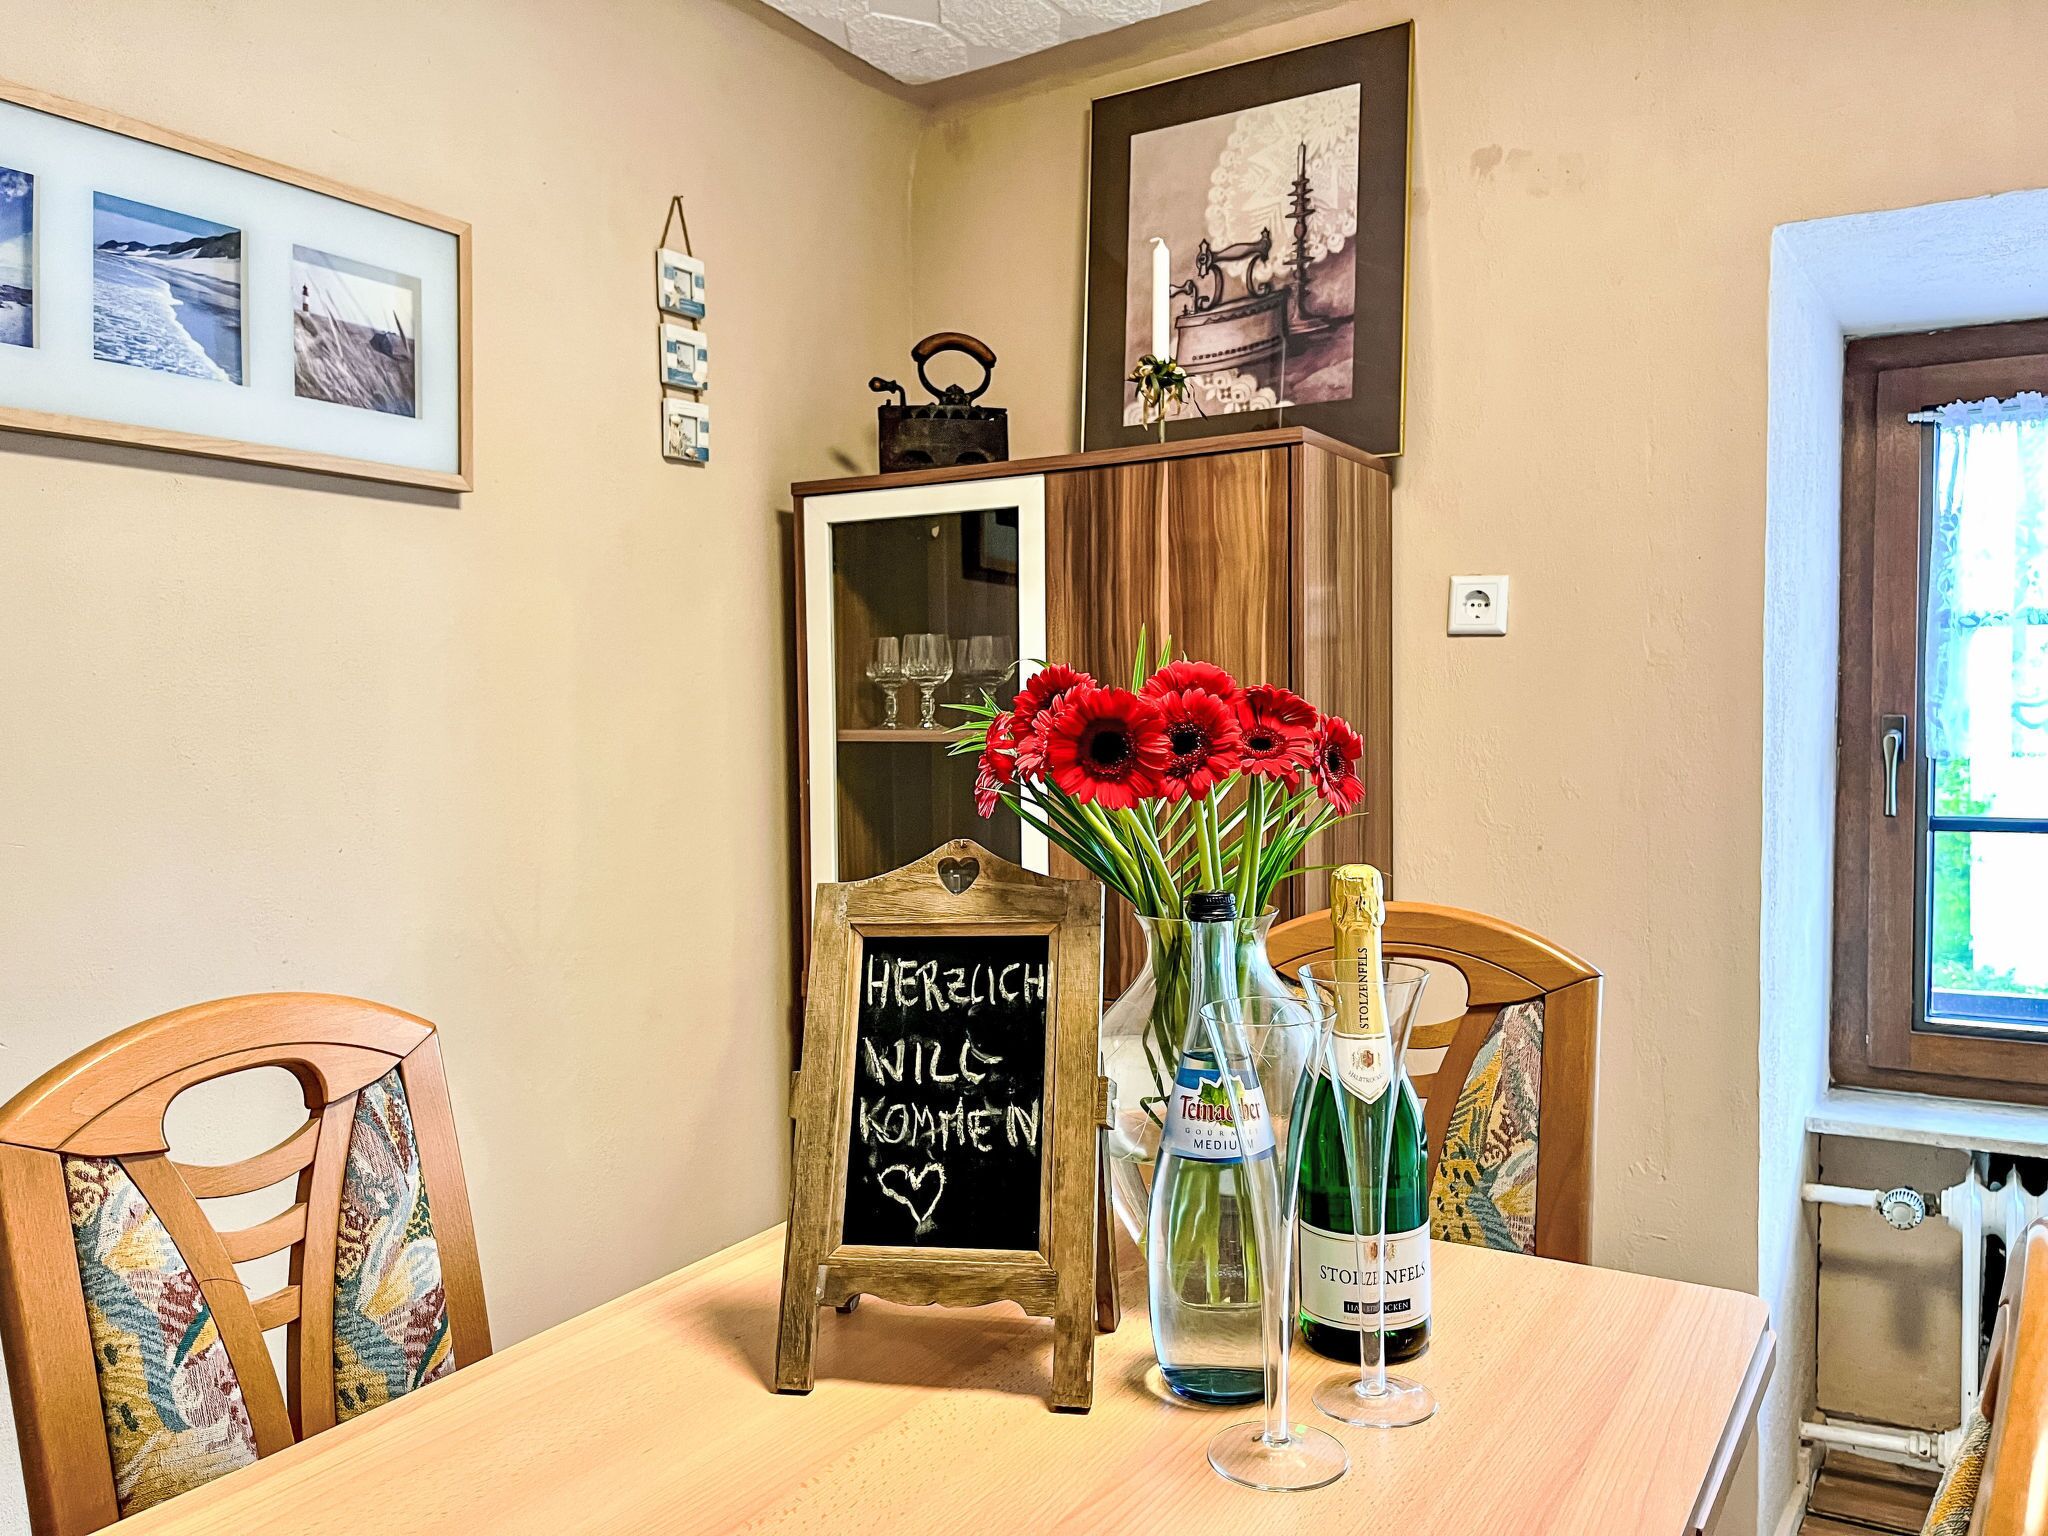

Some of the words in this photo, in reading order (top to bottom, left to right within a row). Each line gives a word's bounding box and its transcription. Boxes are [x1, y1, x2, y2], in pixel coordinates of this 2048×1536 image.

[866, 953, 1046, 1012] HERZLICH
[1357, 947, 1370, 1030] STOLZENFELS
[859, 1095, 1040, 1151] KOMMEN
